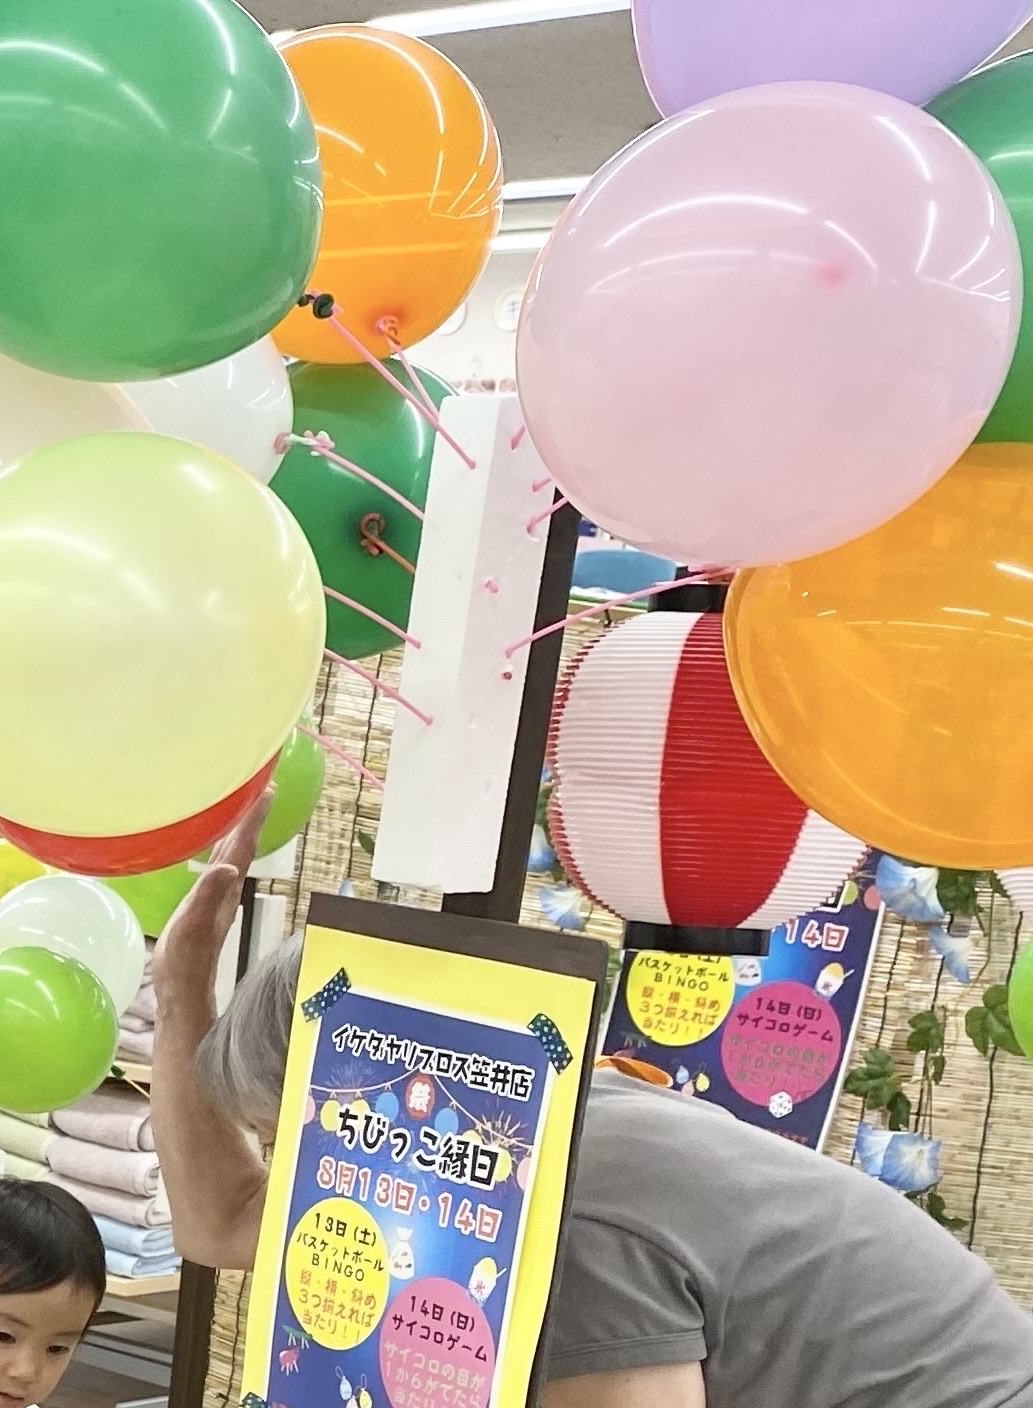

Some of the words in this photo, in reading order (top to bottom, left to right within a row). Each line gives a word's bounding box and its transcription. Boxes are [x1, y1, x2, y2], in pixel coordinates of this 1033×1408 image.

[638, 956, 729, 982] バスケットボール
[654, 972, 709, 991] BINGO
[737, 1012, 834, 1042] サイコロゲーム
[756, 997, 822, 1021] 14日(日)
[337, 1105, 500, 1191] ちびっこ縁日
[317, 1155, 503, 1243] 8月13日・14日
[315, 1212, 377, 1247] 13日(土)
[296, 1231, 385, 1272] バスケットボール
[311, 1252, 365, 1282] BINGO
[298, 1288, 376, 1328] 3つ揃えれば
[411, 1295, 475, 1333] 14日(日)
[391, 1313, 487, 1362] サイコロゲーム
